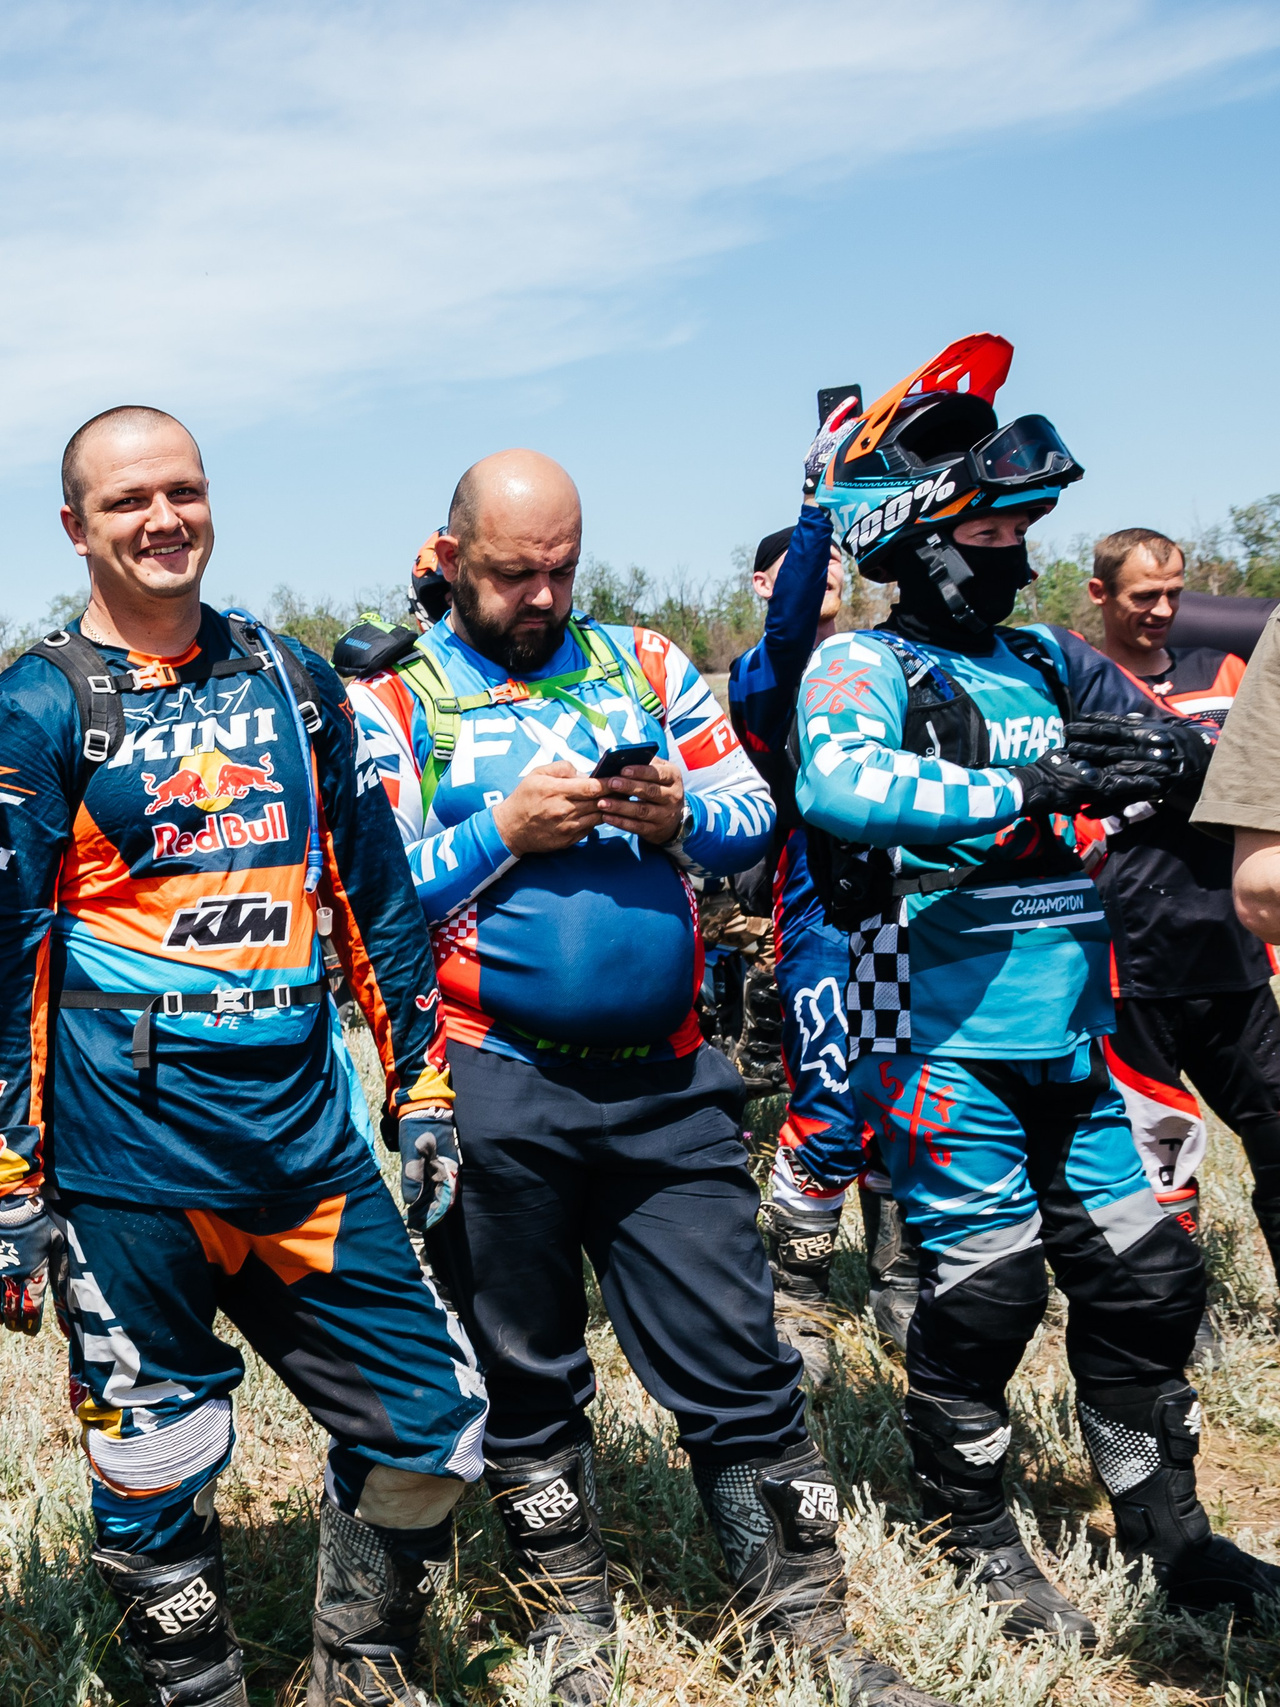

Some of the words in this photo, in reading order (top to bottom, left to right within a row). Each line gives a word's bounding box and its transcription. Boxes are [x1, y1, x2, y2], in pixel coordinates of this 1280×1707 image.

[846, 468, 956, 556] 100%
[107, 707, 279, 770] KINI
[152, 814, 224, 860] Red
[221, 801, 290, 850] Bull
[163, 893, 291, 950] KTM
[1011, 894, 1084, 916] CHAMPION
